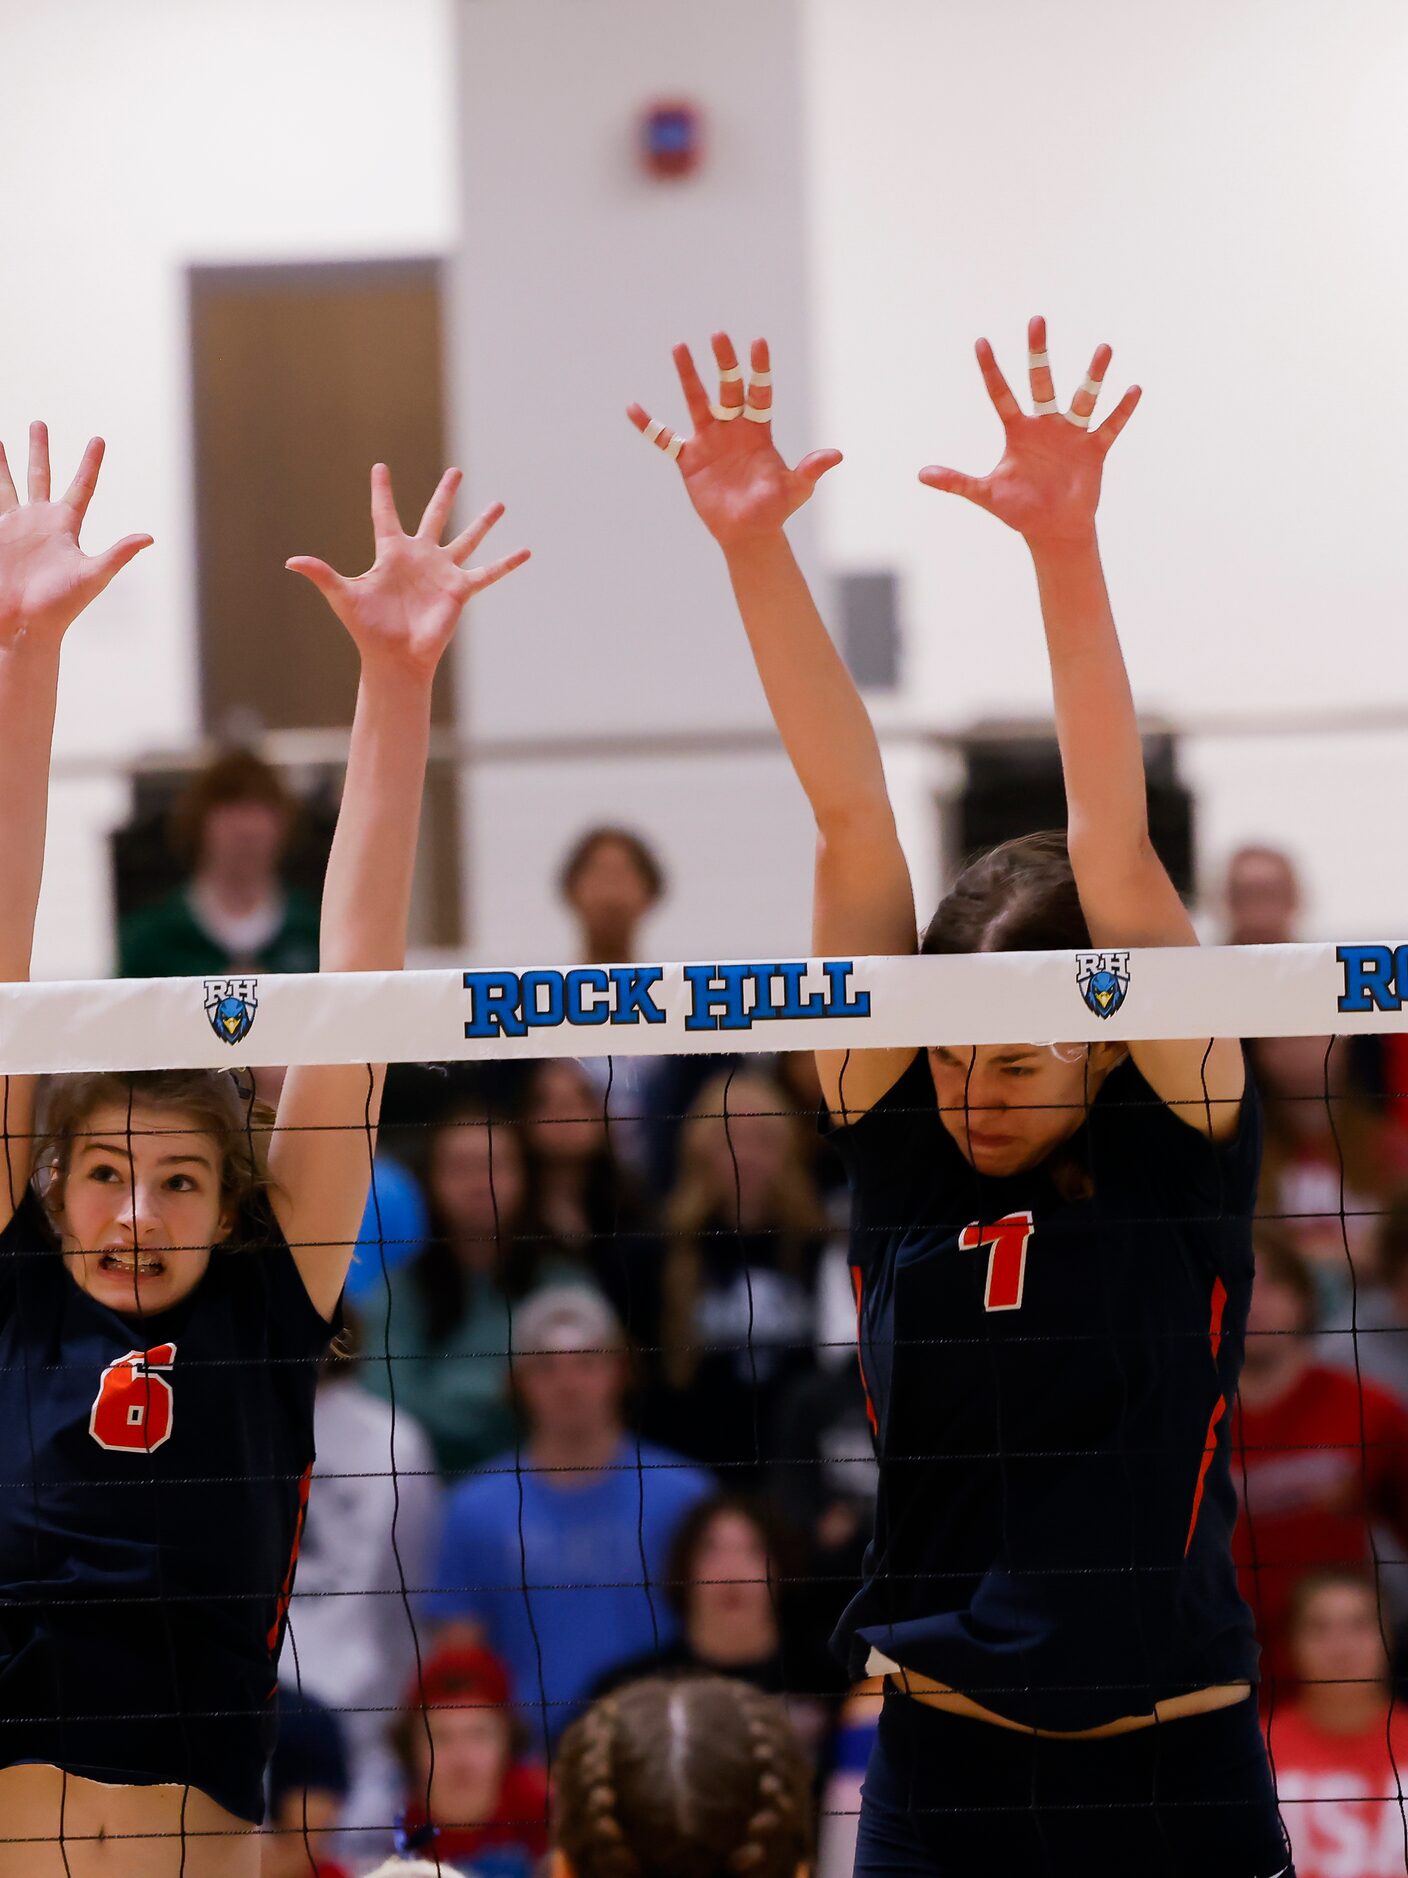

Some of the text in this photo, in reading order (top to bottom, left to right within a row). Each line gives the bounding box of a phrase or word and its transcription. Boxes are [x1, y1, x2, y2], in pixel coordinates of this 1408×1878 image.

[203, 979, 258, 1009] RH
[463, 961, 871, 1039] ROCK HILL
[1076, 952, 1131, 983] RH
[958, 1210, 1034, 1312] 7
[88, 1342, 177, 1453] 6
